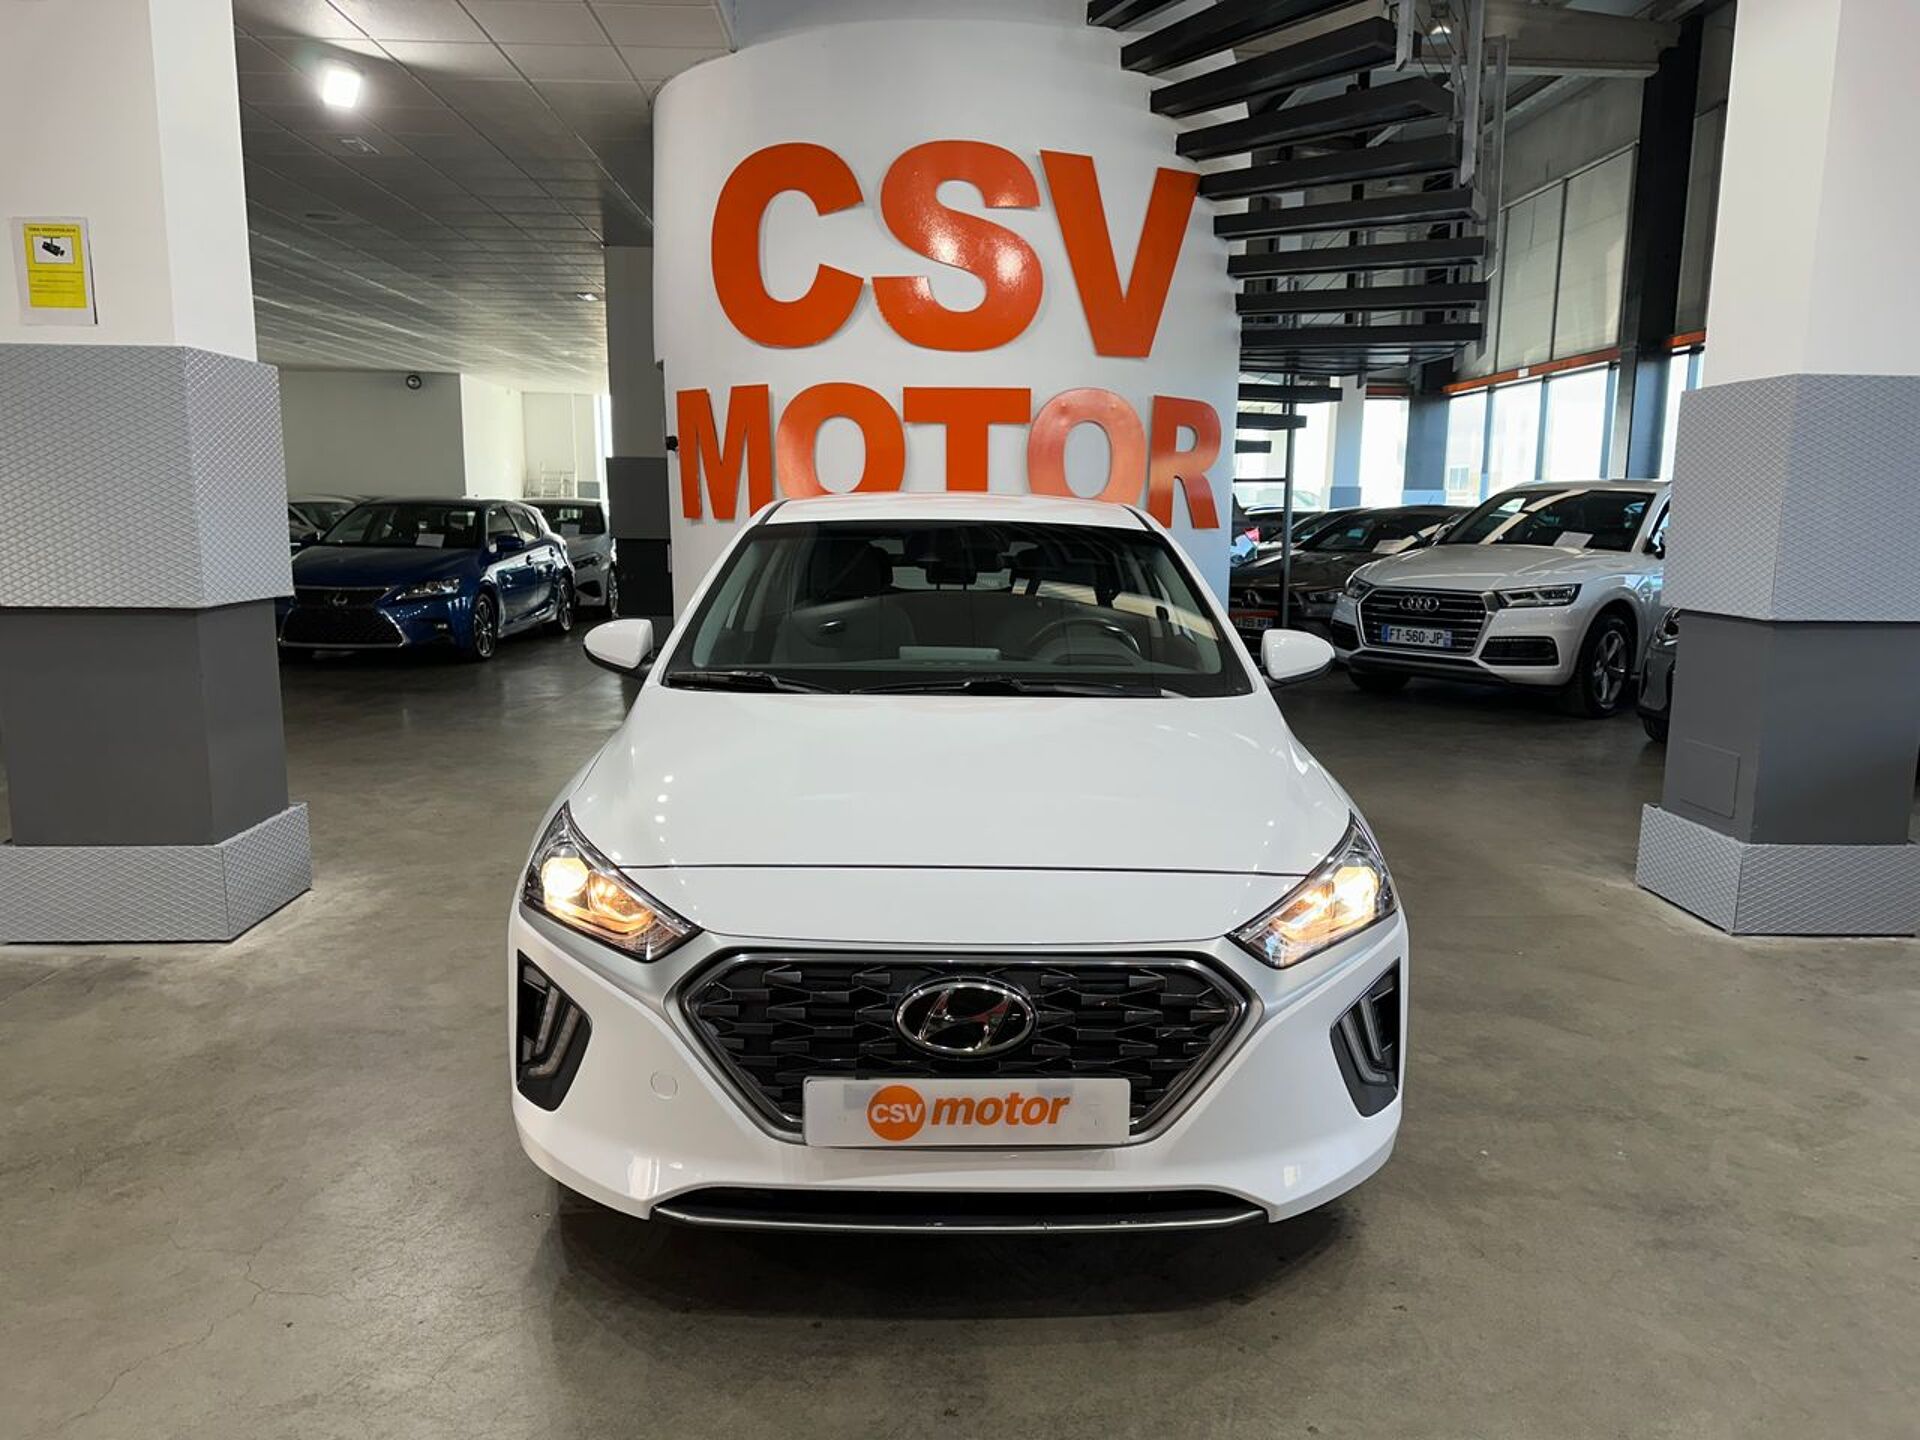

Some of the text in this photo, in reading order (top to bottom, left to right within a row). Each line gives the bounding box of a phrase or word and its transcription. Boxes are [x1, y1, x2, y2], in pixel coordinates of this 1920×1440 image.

[711, 140, 1201, 358] CSV
[677, 382, 1221, 529] MOTOR
[872, 1092, 1071, 1125] CSV motor
